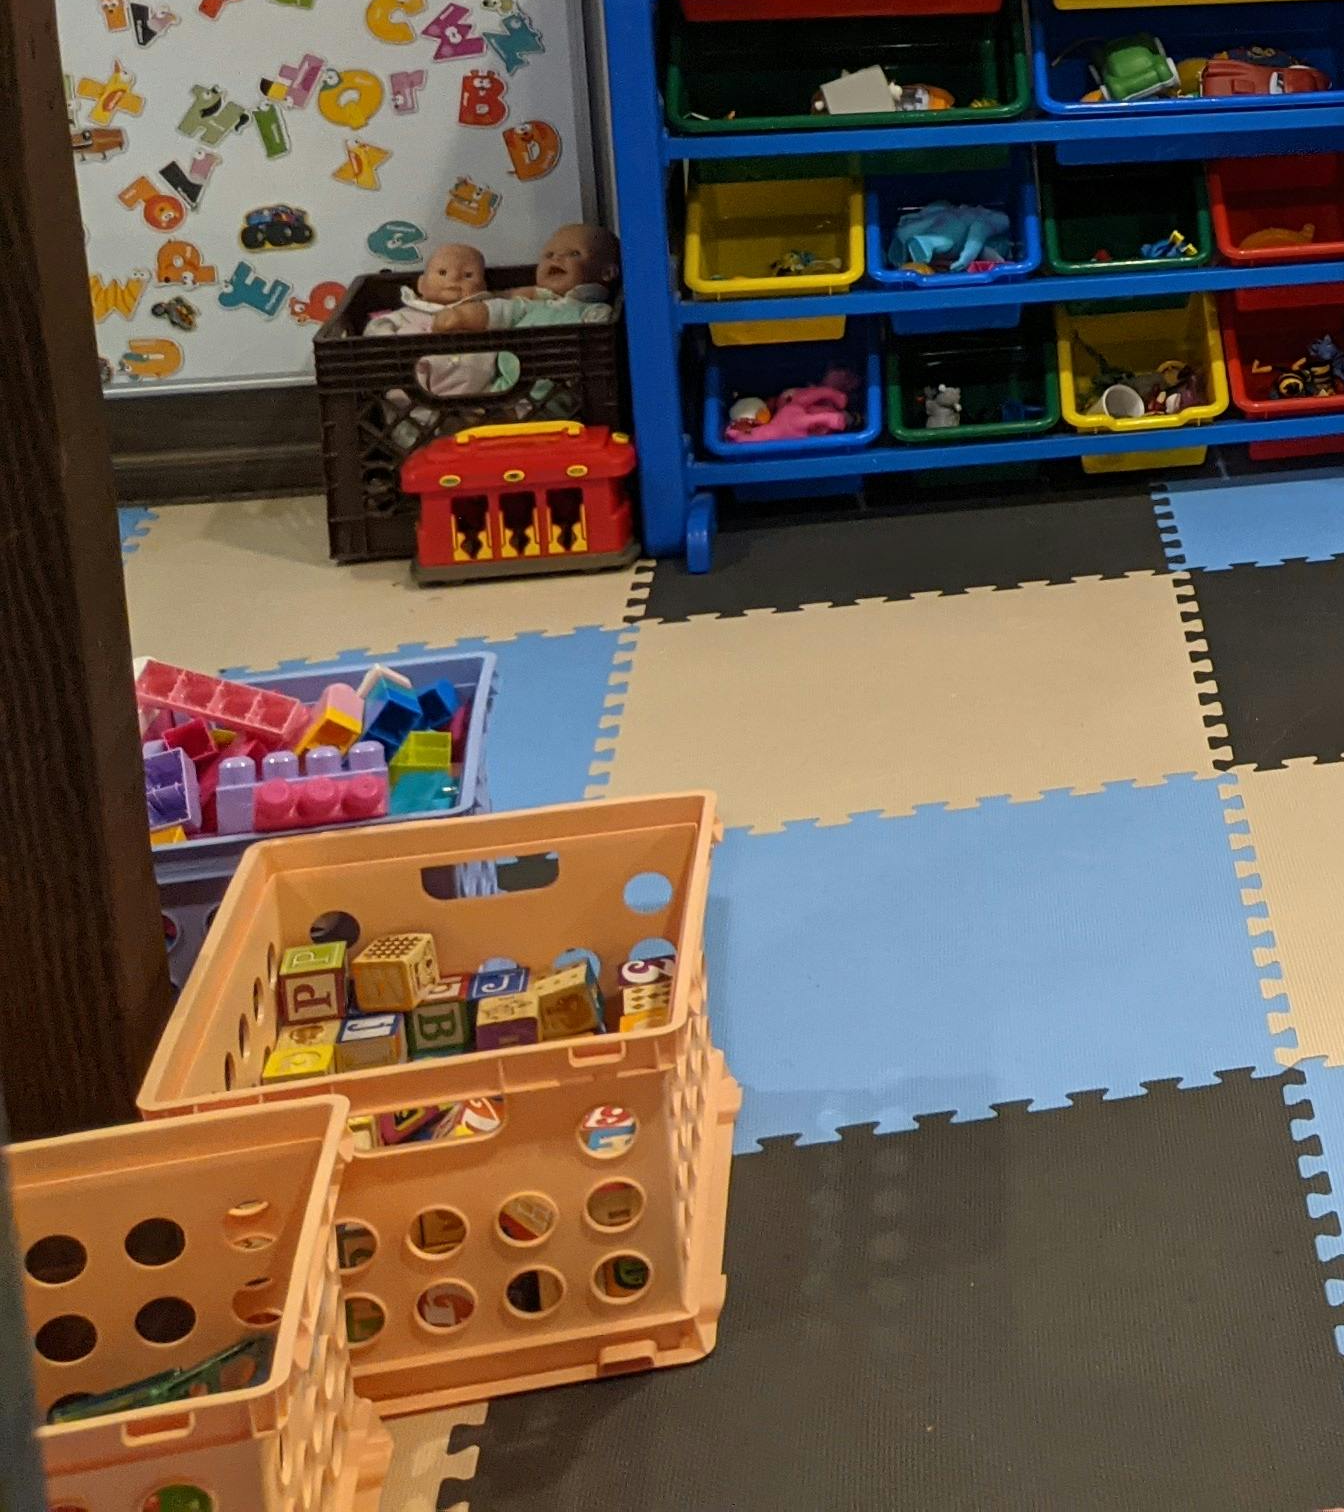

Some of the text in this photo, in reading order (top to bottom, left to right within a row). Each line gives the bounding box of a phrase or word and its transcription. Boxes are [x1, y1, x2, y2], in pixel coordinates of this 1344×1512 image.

[459, 68, 509, 128] B
[503, 120, 562, 181] D
[293, 983, 332, 1014] P
[480, 973, 512, 993] J
[418, 1010, 456, 1042] B
